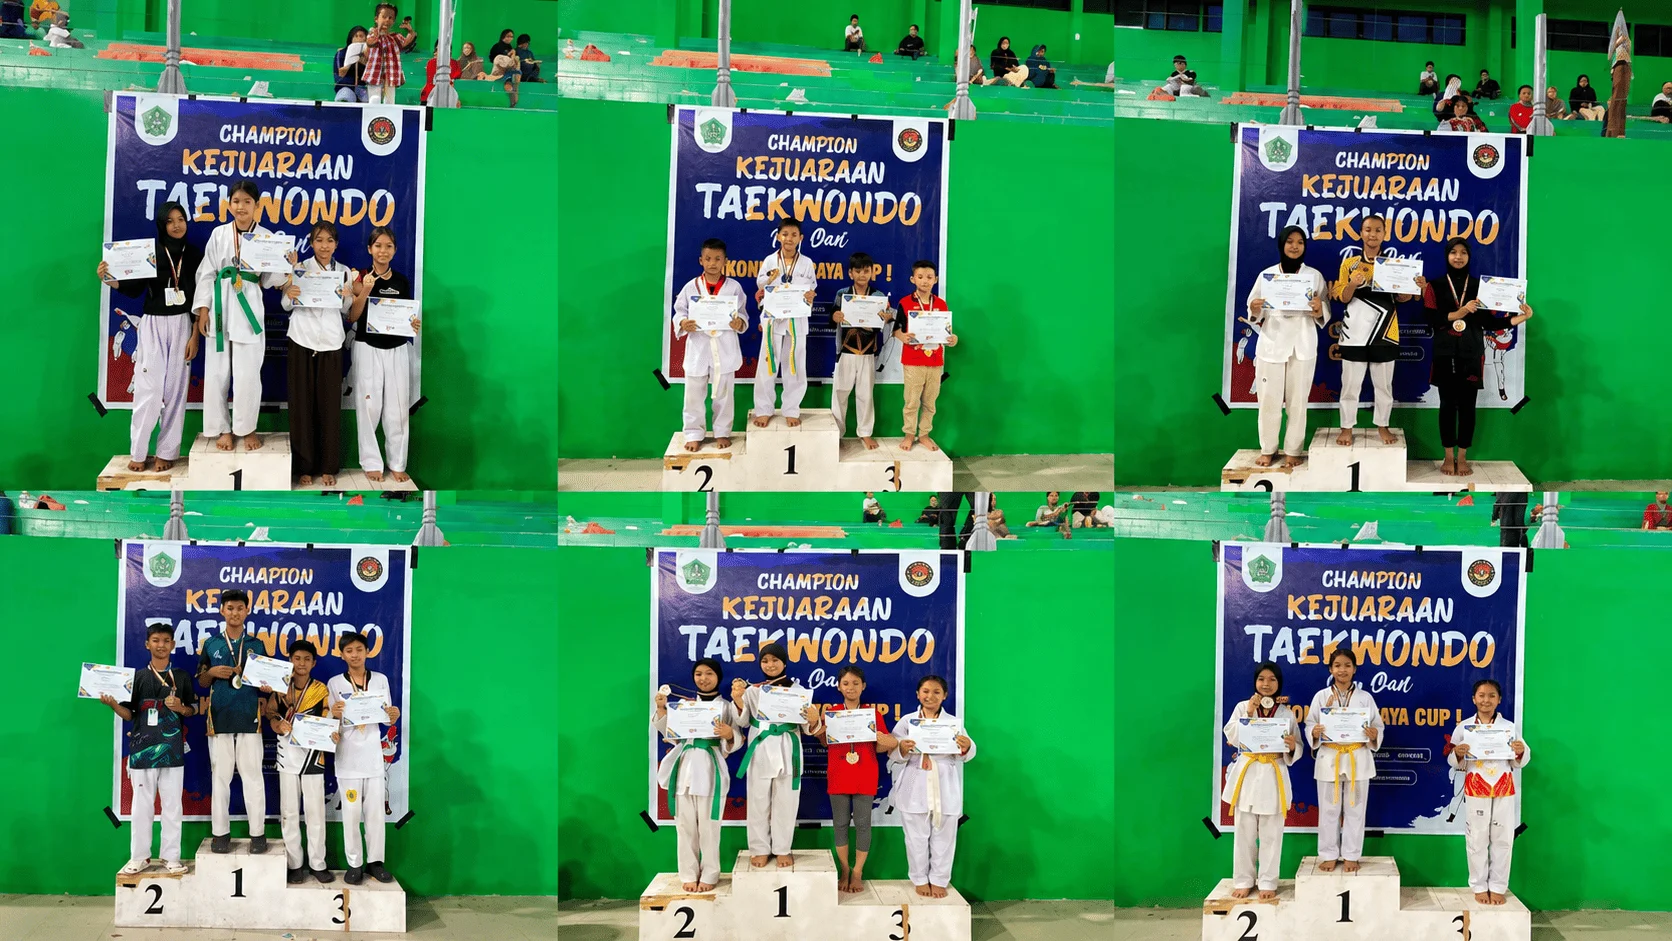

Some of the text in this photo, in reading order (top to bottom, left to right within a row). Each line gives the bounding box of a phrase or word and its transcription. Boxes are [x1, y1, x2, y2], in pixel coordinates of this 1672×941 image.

[219, 124, 322, 147] CHAMPION
[768, 134, 858, 154] CHAMPION
[182, 148, 354, 181] KEJUARAAN
[735, 156, 885, 184] KEJUARAAN
[1335, 151, 1430, 171] CHAMPION
[1302, 174, 1460, 201] KEJUARAAN
[695, 182, 922, 226] TAEKWONDO
[812, 262, 844, 280] AYA
[783, 445, 799, 475] 1
[694, 465, 715, 492] 2
[1346, 461, 1363, 492] 1
[757, 572, 859, 591] CHAMPION
[1322, 569, 1422, 590] CHAMPION
[722, 595, 892, 621] KEJUARAAN
[1287, 593, 1454, 624] KEJUARAAN
[1243, 624, 1496, 669] TAEKWONDO
[1380, 707, 1409, 726] AYA
[1414, 707, 1451, 727] CUP
[230, 867, 247, 898] 1
[144, 883, 165, 915] 2
[331, 893, 351, 924] 3
[773, 885, 792, 918] 1
[1335, 889, 1354, 923] 1
[673, 906, 697, 939] 2
[888, 909, 911, 941] 3
[1236, 910, 1259, 941] 2
